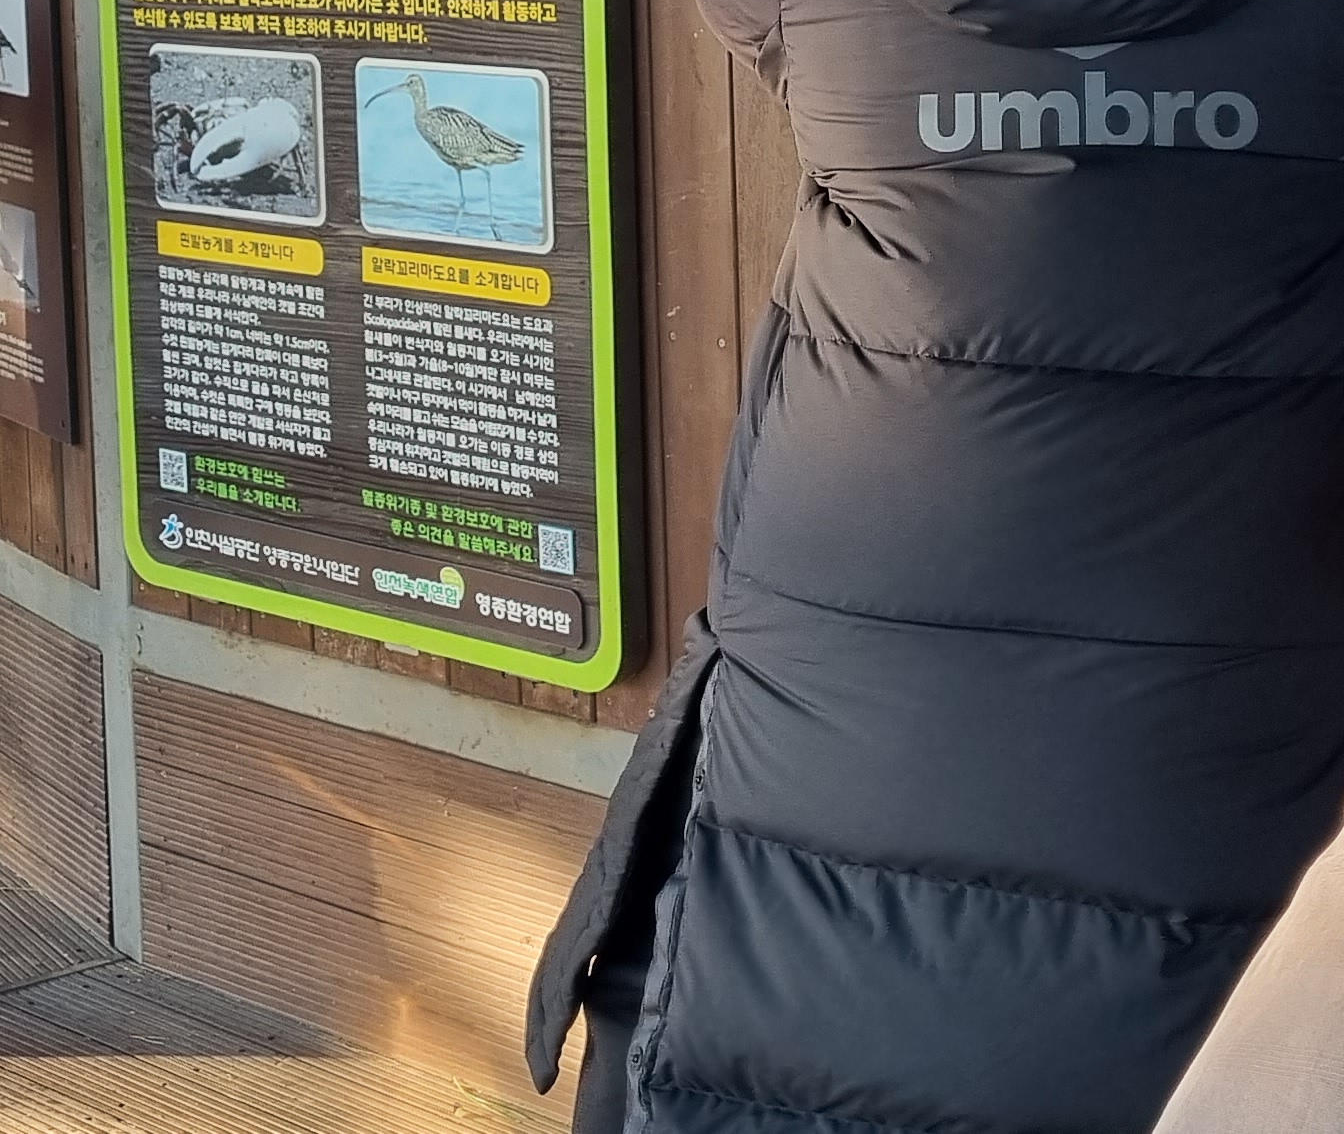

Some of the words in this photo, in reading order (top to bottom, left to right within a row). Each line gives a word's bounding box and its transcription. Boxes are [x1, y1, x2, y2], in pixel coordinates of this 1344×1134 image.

[133, 8, 168, 27] 번식할
[167, 11, 181, 25] 수
[183, 11, 218, 28] 있도록
[219, 13, 255, 31] 보호에
[257, 14, 281, 32] 적극
[283, 16, 333, 35] 협조하여
[334, 19, 372, 37] 주시기
[371, 22, 426, 42] 바랍니다.
[501, 0, 556, 21] 활동하고
[917, 70, 1259, 153] umbro
[179, 231, 233, 253] 흰발농게를
[238, 240, 294, 261] 소개합니다
[371, 256, 469, 285] 알락꼬리마도요를
[475, 270, 539, 294] 소개합니다
[194, 455, 249, 480] 환경보호에
[252, 467, 286, 489] 힘쓰는
[196, 478, 239, 501] 우리들을
[243, 489, 302, 512] 소개합니다.
[361, 488, 422, 516] 멸종위기종
[425, 502, 438, 520] 및
[441, 504, 505, 533] 환경보호에
[507, 518, 534, 540] 관한
[185, 526, 261, 563] 인천시설공단
[263, 544, 360, 586] 영종공원사업단
[389, 518, 415, 536] 좋은
[418, 523, 455, 547] 의견을
[458, 531, 538, 563] 말씀해주세요.
[372, 568, 460, 608] 인천녹색연합
[475, 591, 572, 635] 영종환경연합
